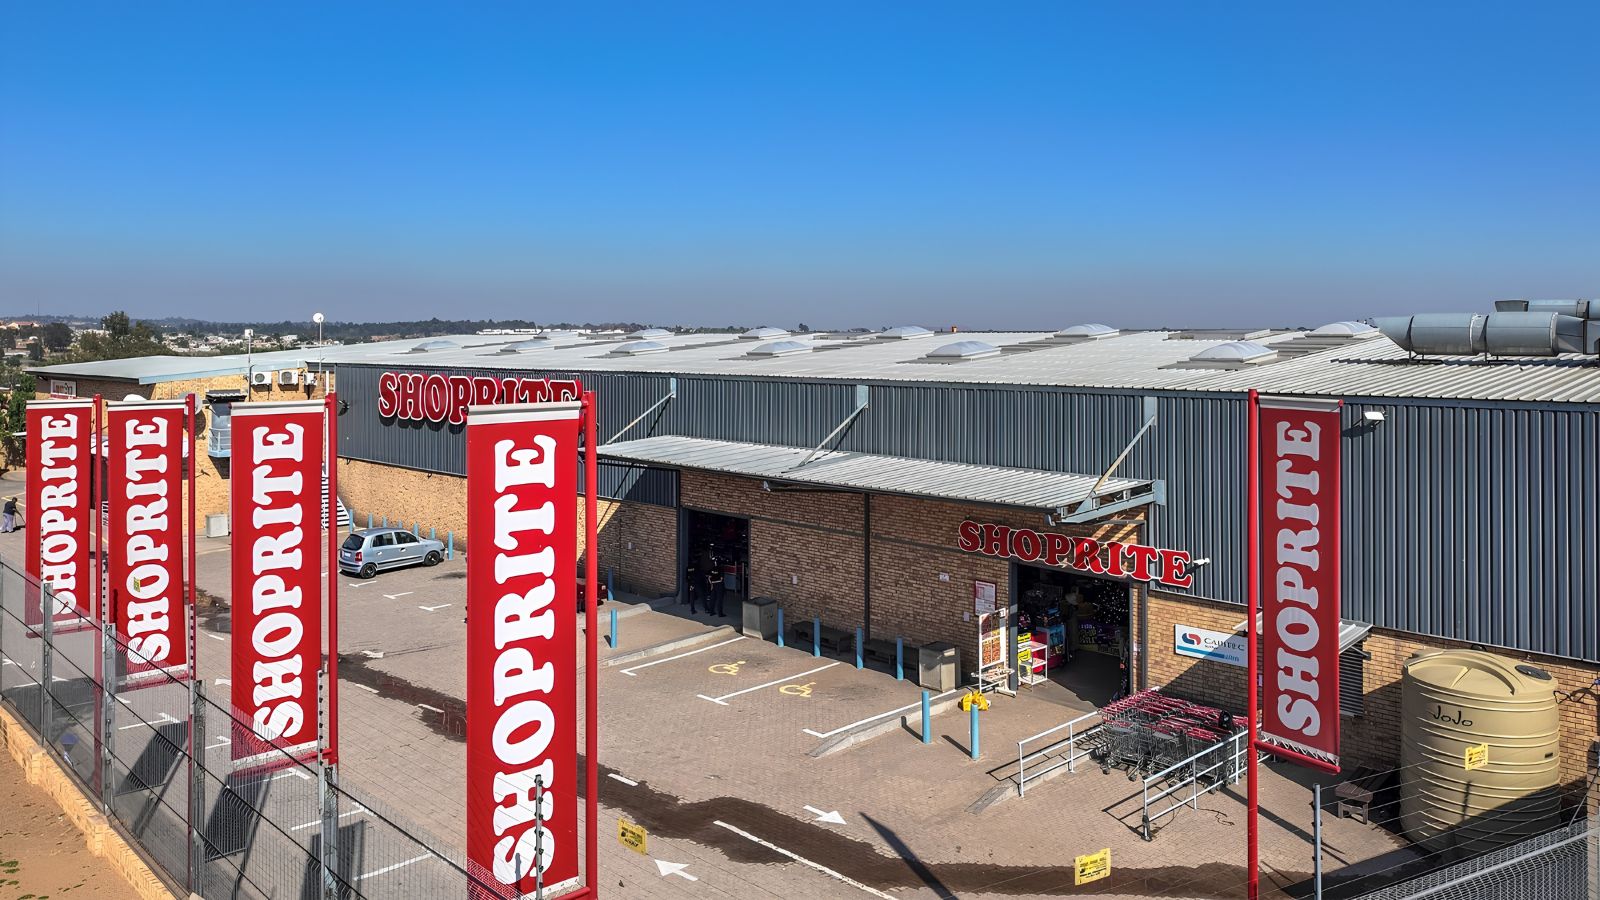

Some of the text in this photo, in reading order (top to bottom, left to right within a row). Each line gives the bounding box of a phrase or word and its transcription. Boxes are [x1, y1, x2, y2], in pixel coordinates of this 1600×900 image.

[126, 417, 170, 664] SHOPRITE
[252, 423, 304, 742] SHOPRITE
[492, 434, 557, 885] SHOPRITE
[958, 520, 1194, 589] SHOPRITE
[1276, 420, 1322, 737] SHOPRITE
[1427, 705, 1473, 727] JoJo
